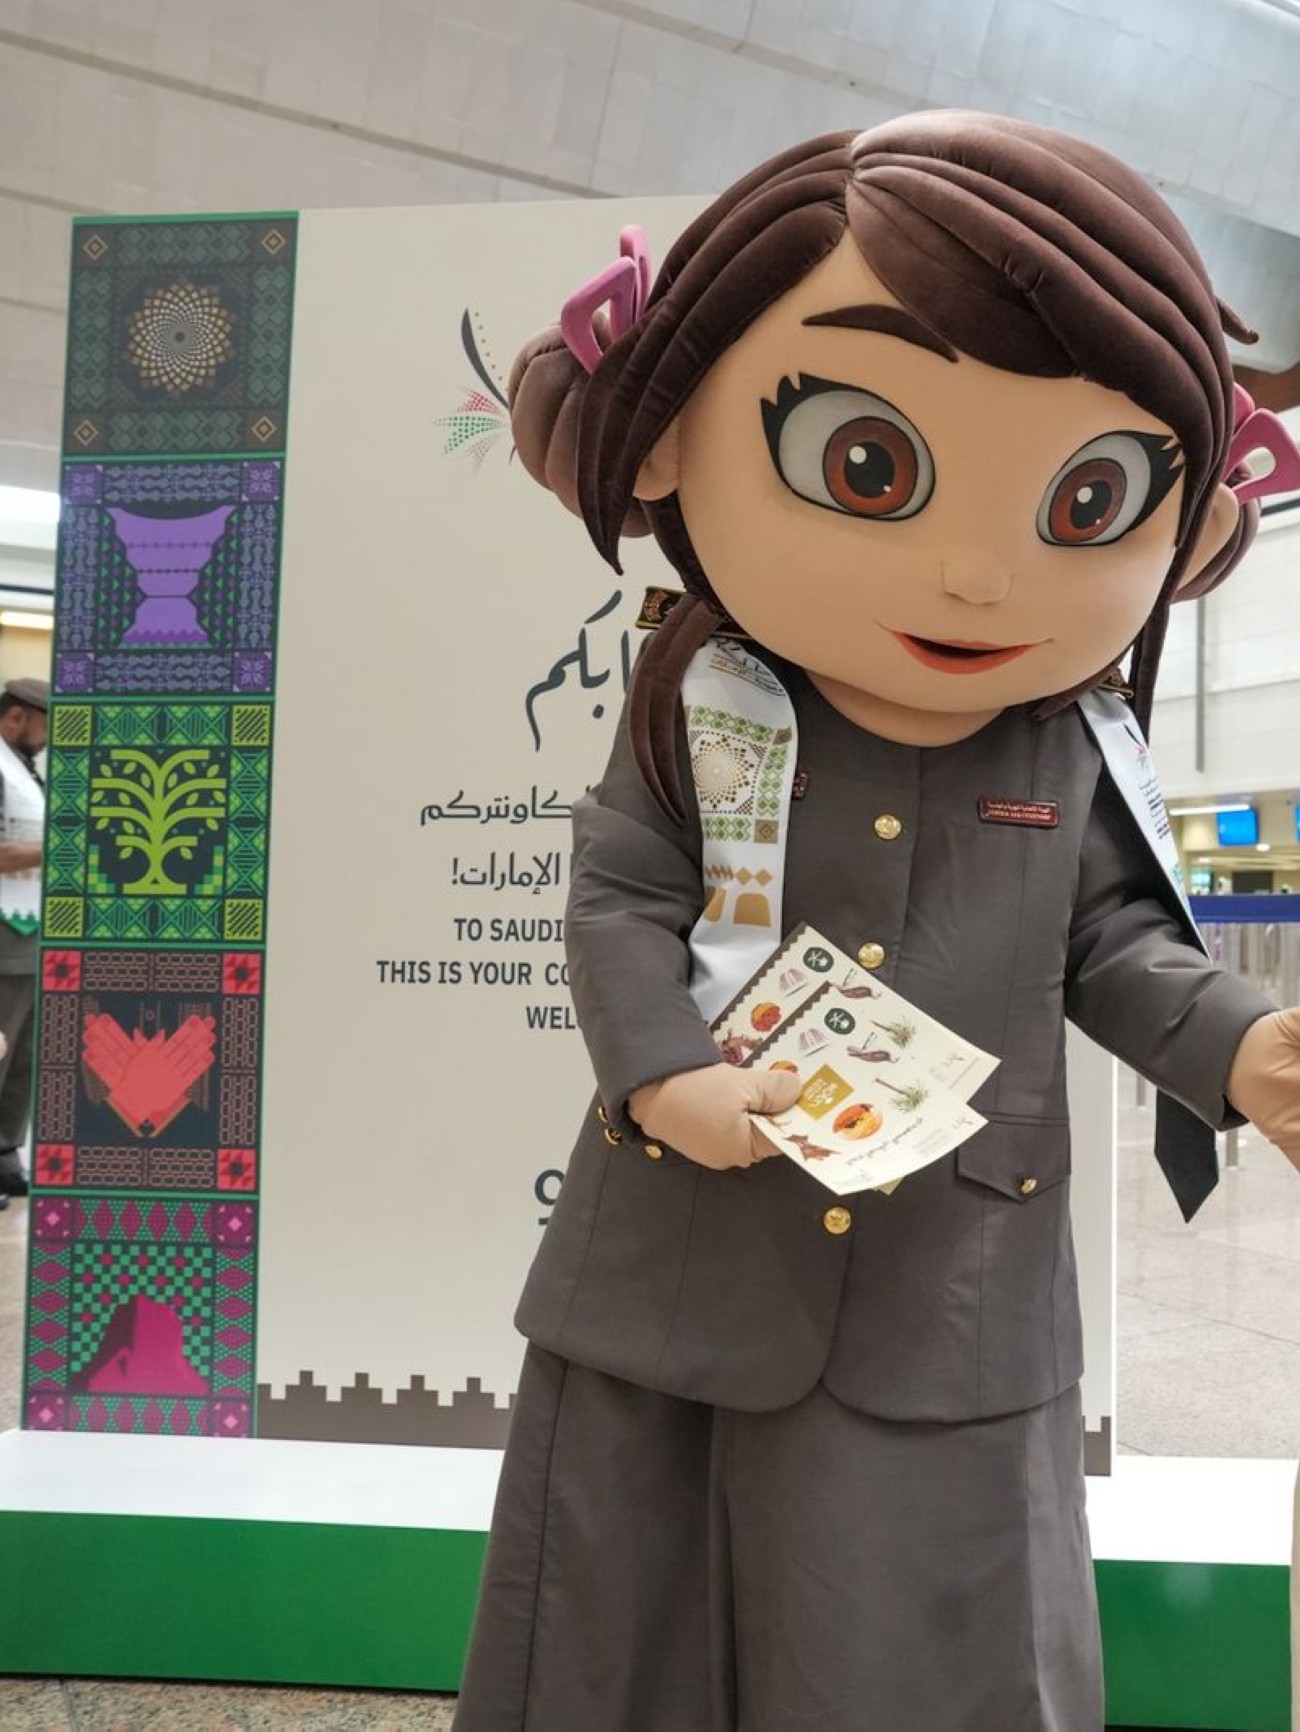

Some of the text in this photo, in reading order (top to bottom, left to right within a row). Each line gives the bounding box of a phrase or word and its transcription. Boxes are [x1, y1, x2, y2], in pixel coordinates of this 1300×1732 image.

[451, 852, 560, 895] الإمارات!
[454, 918, 563, 942] TO SAUDI
[376, 960, 431, 984] THIS
[438, 961, 462, 984] IS
[469, 961, 532, 985] YOUR
